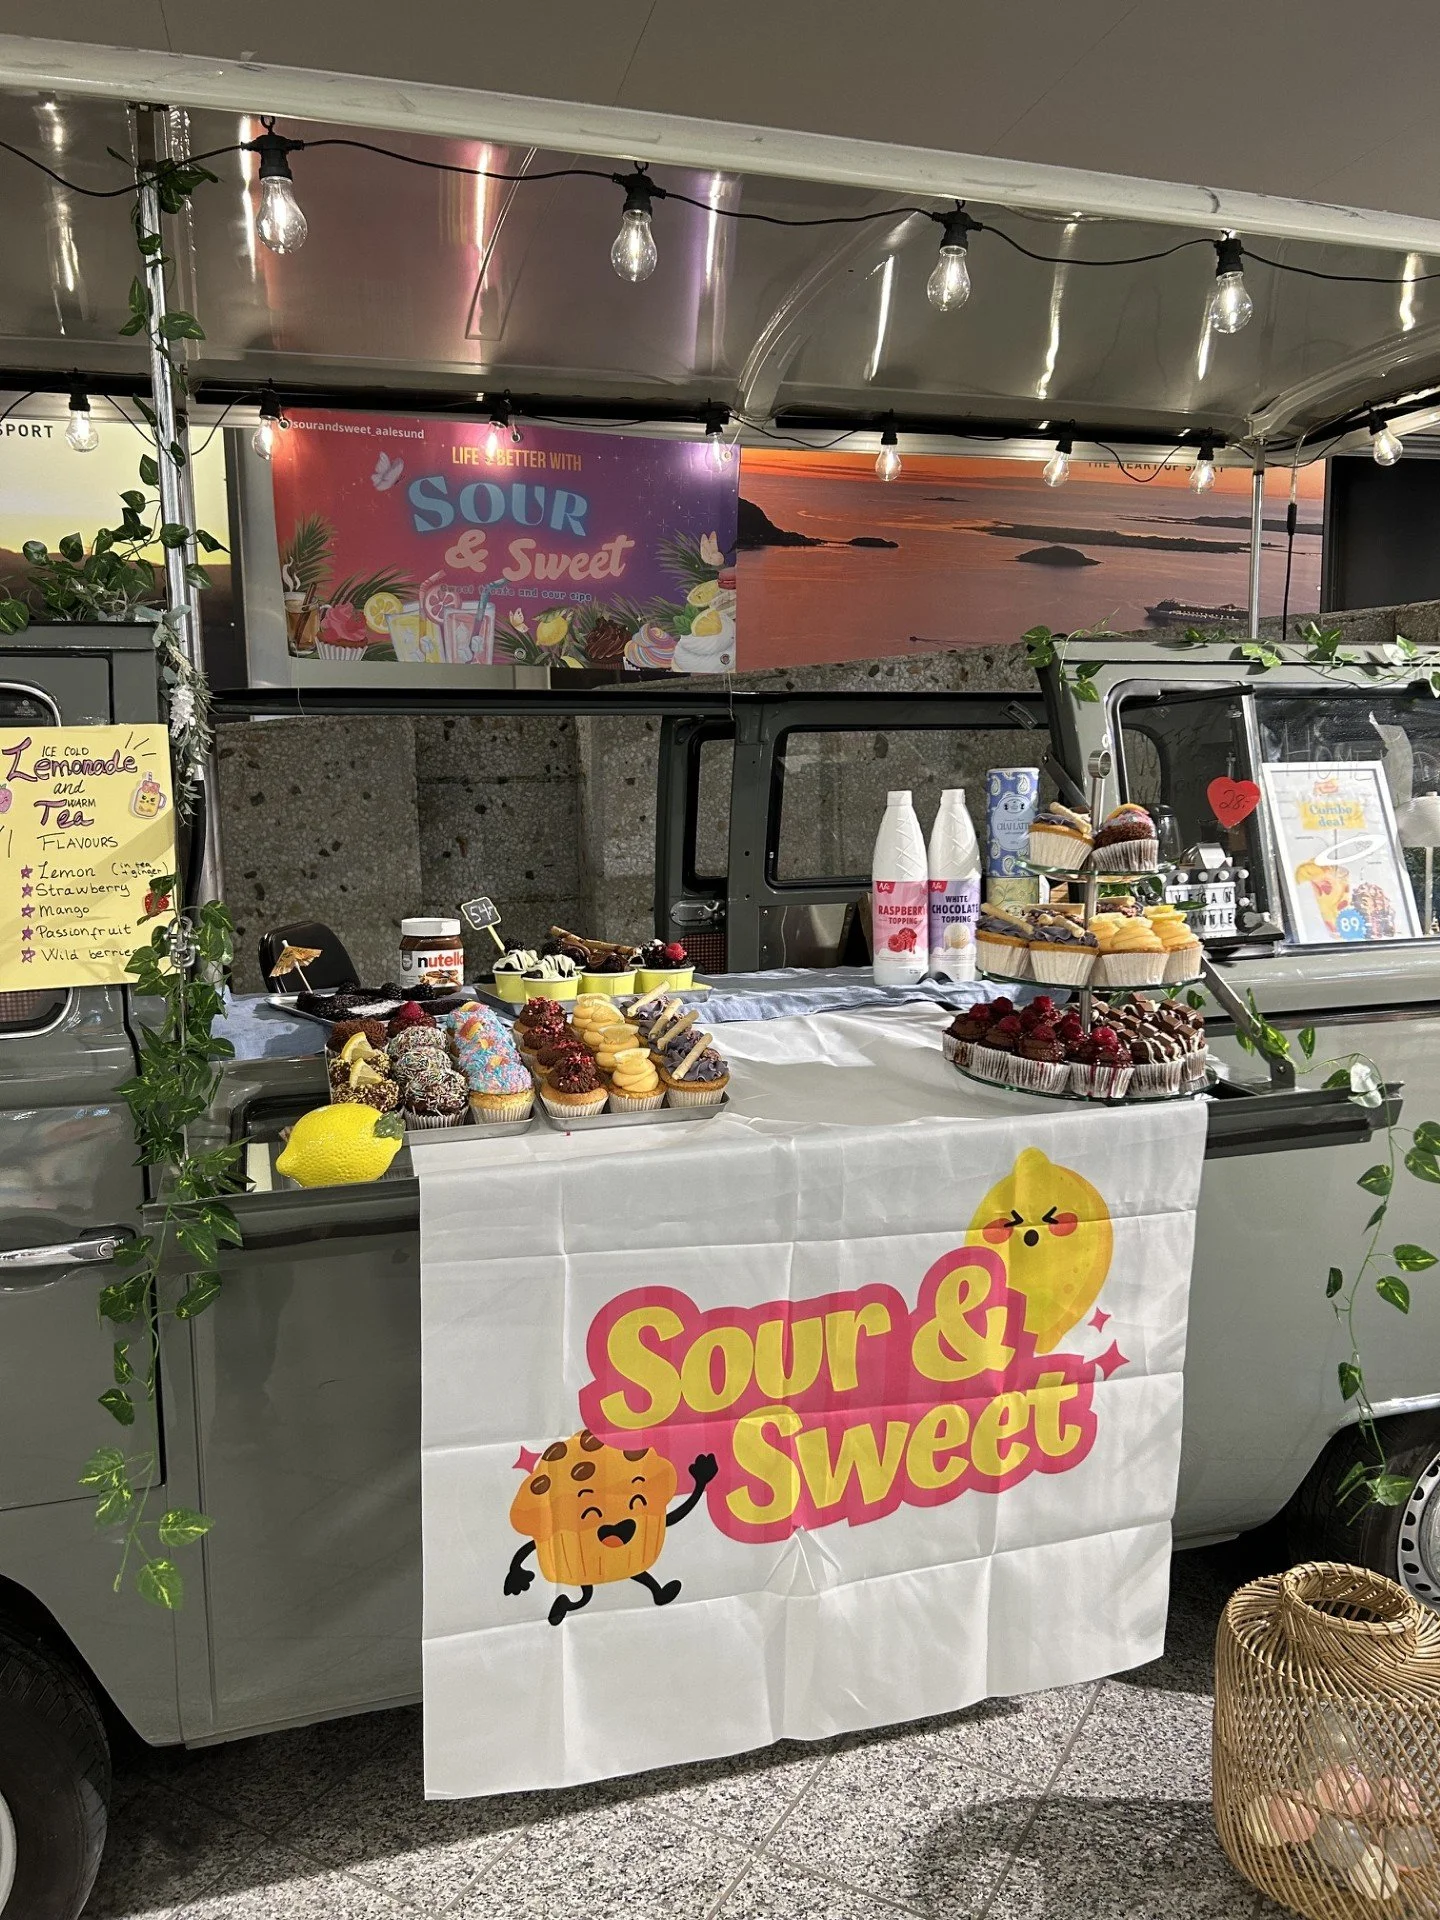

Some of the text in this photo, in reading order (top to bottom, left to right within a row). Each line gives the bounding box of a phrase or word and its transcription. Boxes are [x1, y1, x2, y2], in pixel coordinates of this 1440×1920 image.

[289, 419, 425, 440] sourandsweet_aalesund
[452, 446, 480, 465] LIFE
[496, 449, 547, 468] BETTER
[550, 452, 582, 471] WITH
[408, 476, 588, 537] SOUR
[444, 529, 636, 582] & Sweet
[518, 587, 538, 598] and
[541, 590, 566, 600] sour
[42, 745, 89, 757] ICE COLD
[2, 736, 138, 782] Lemonade
[53, 779, 85, 794] and
[67, 798, 96, 808] WARM
[33, 799, 94, 829] Tea
[38, 861, 96, 879] Lemon
[35, 883, 131, 897] Strawberry
[945, 895, 969, 903] WHITE
[39, 904, 90, 918] Mango
[931, 903, 979, 915] CHOCOLATE
[888, 916, 918, 925] TOPPING
[941, 915, 972, 924] TOPPING
[35, 924, 132, 940] Passionfruit
[40, 949, 79, 962] Wild
[599, 1264, 1017, 1431] Sour &
[726, 1371, 1083, 1525] Sweet
